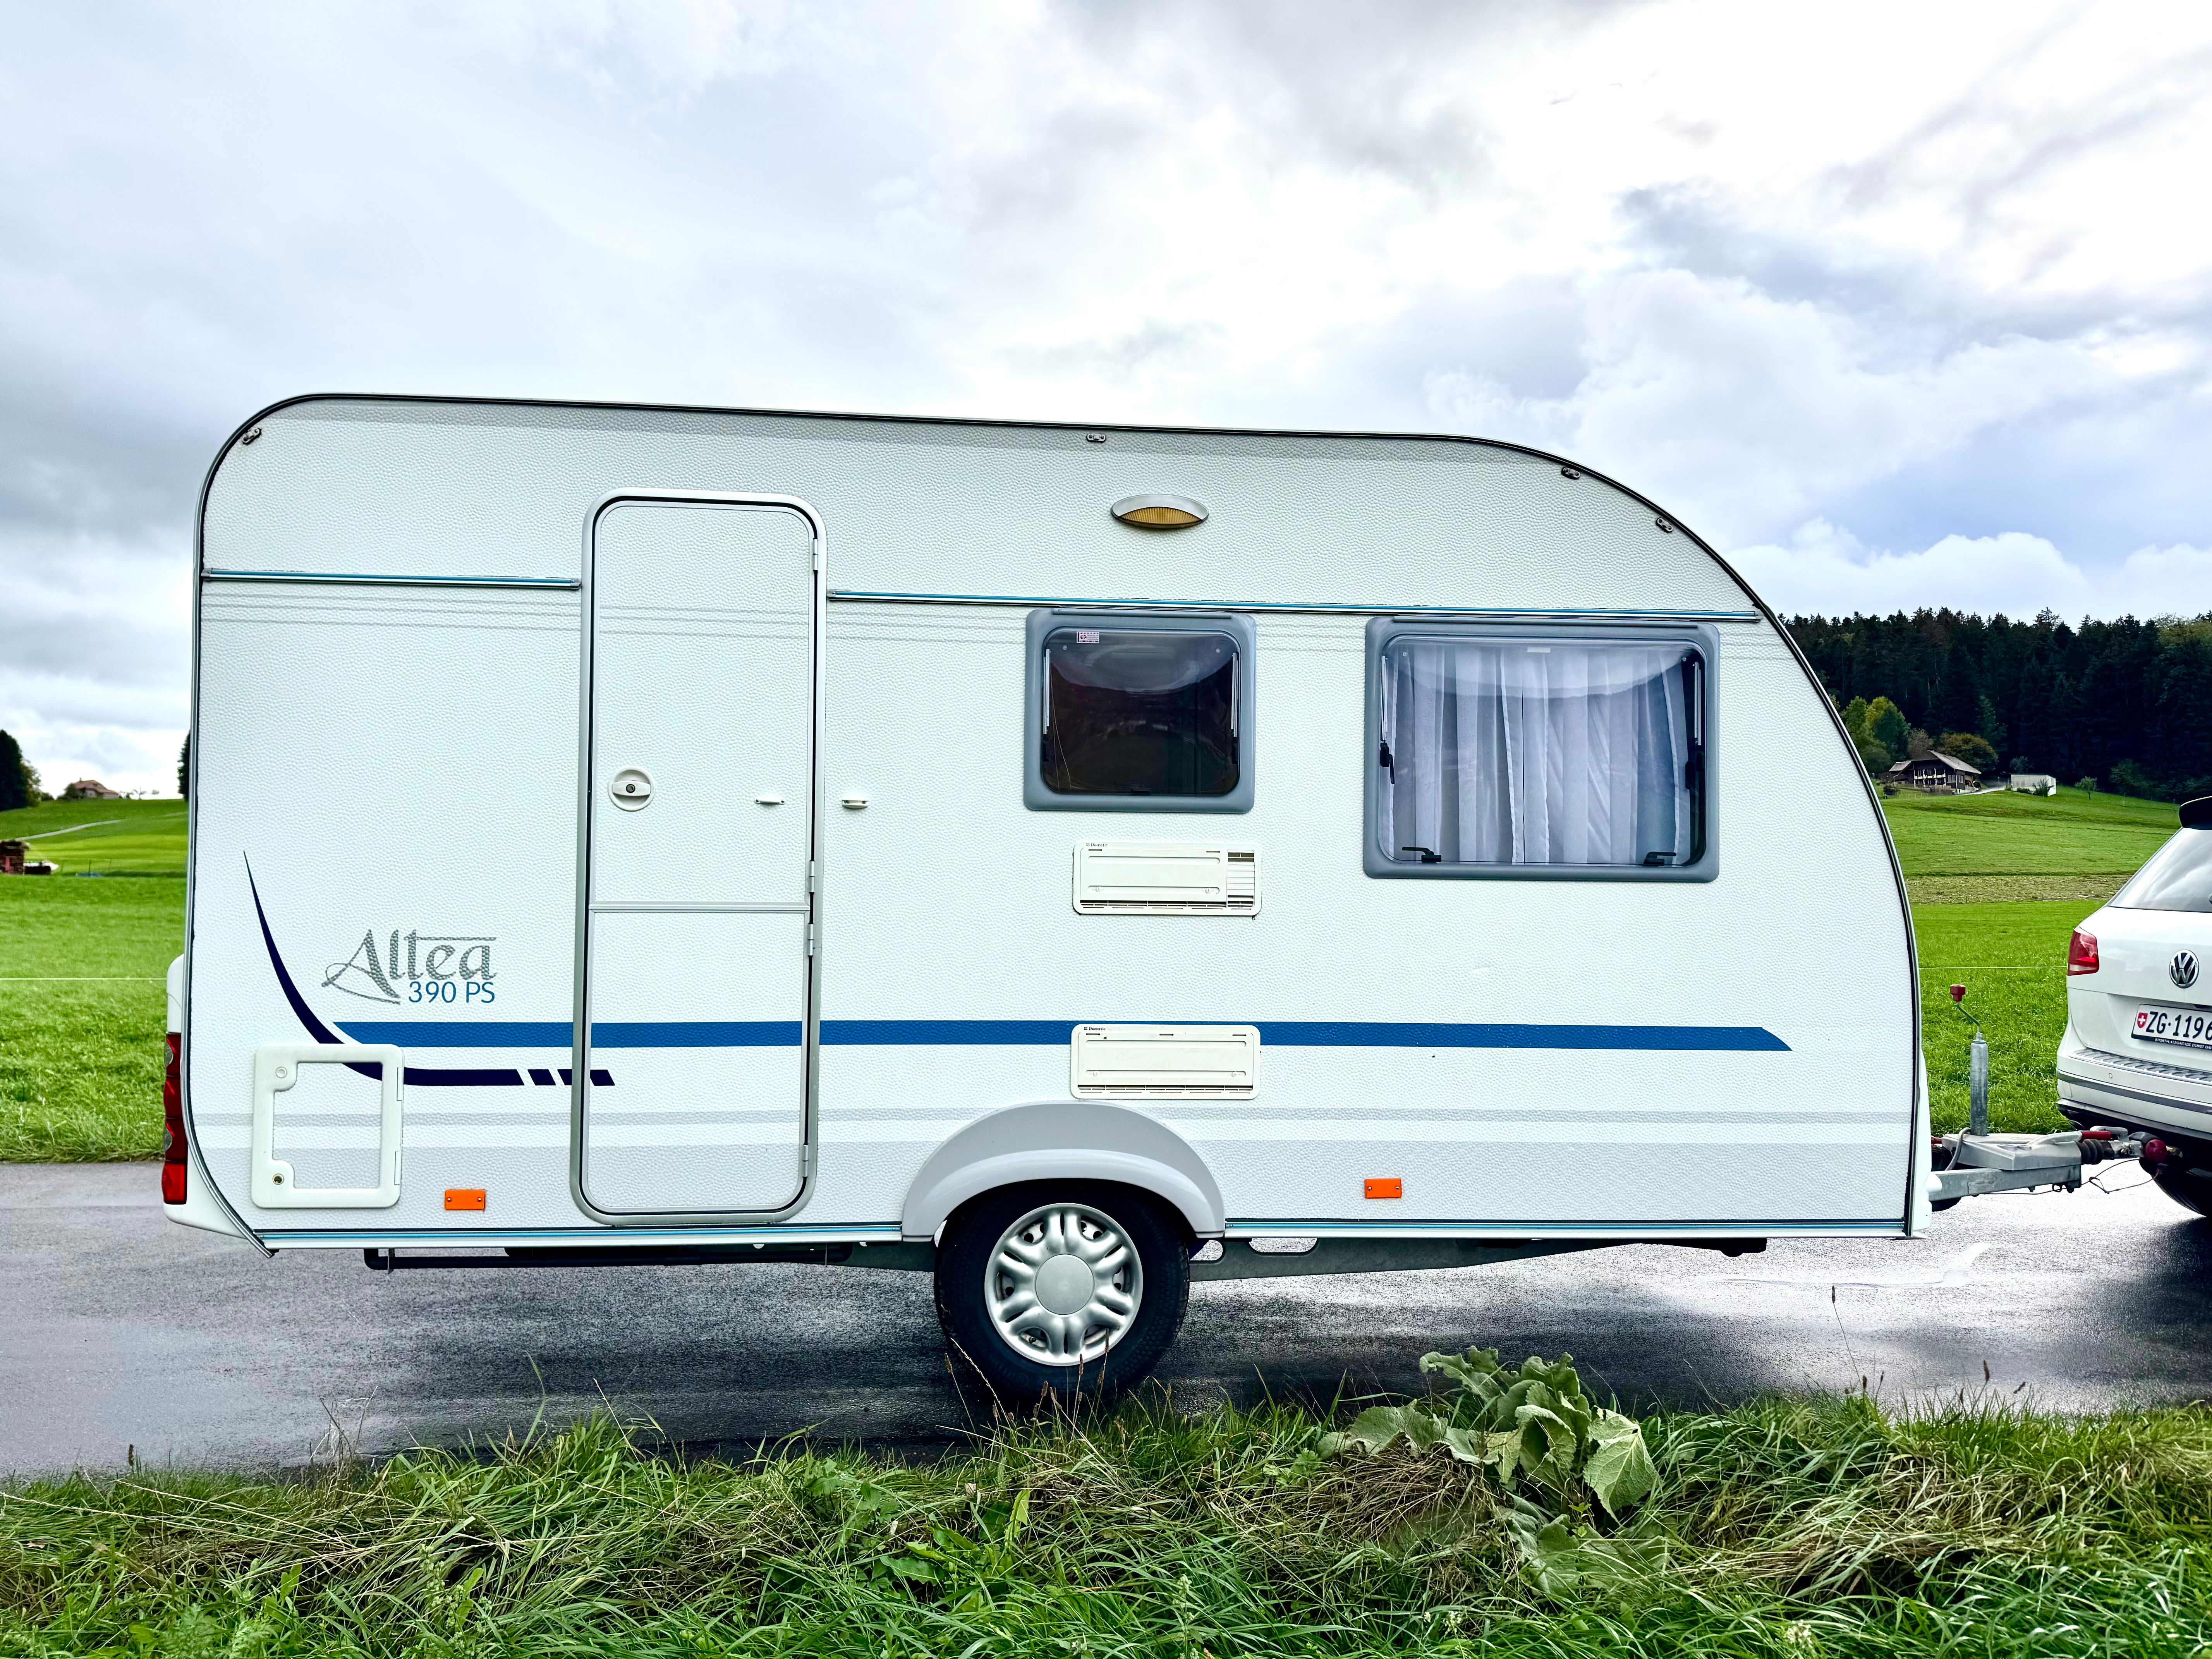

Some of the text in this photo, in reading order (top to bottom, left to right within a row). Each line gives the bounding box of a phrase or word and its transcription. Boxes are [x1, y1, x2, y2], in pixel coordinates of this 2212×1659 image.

[321, 929, 497, 1005] Altea
[409, 981, 495, 1003] 390 PS
